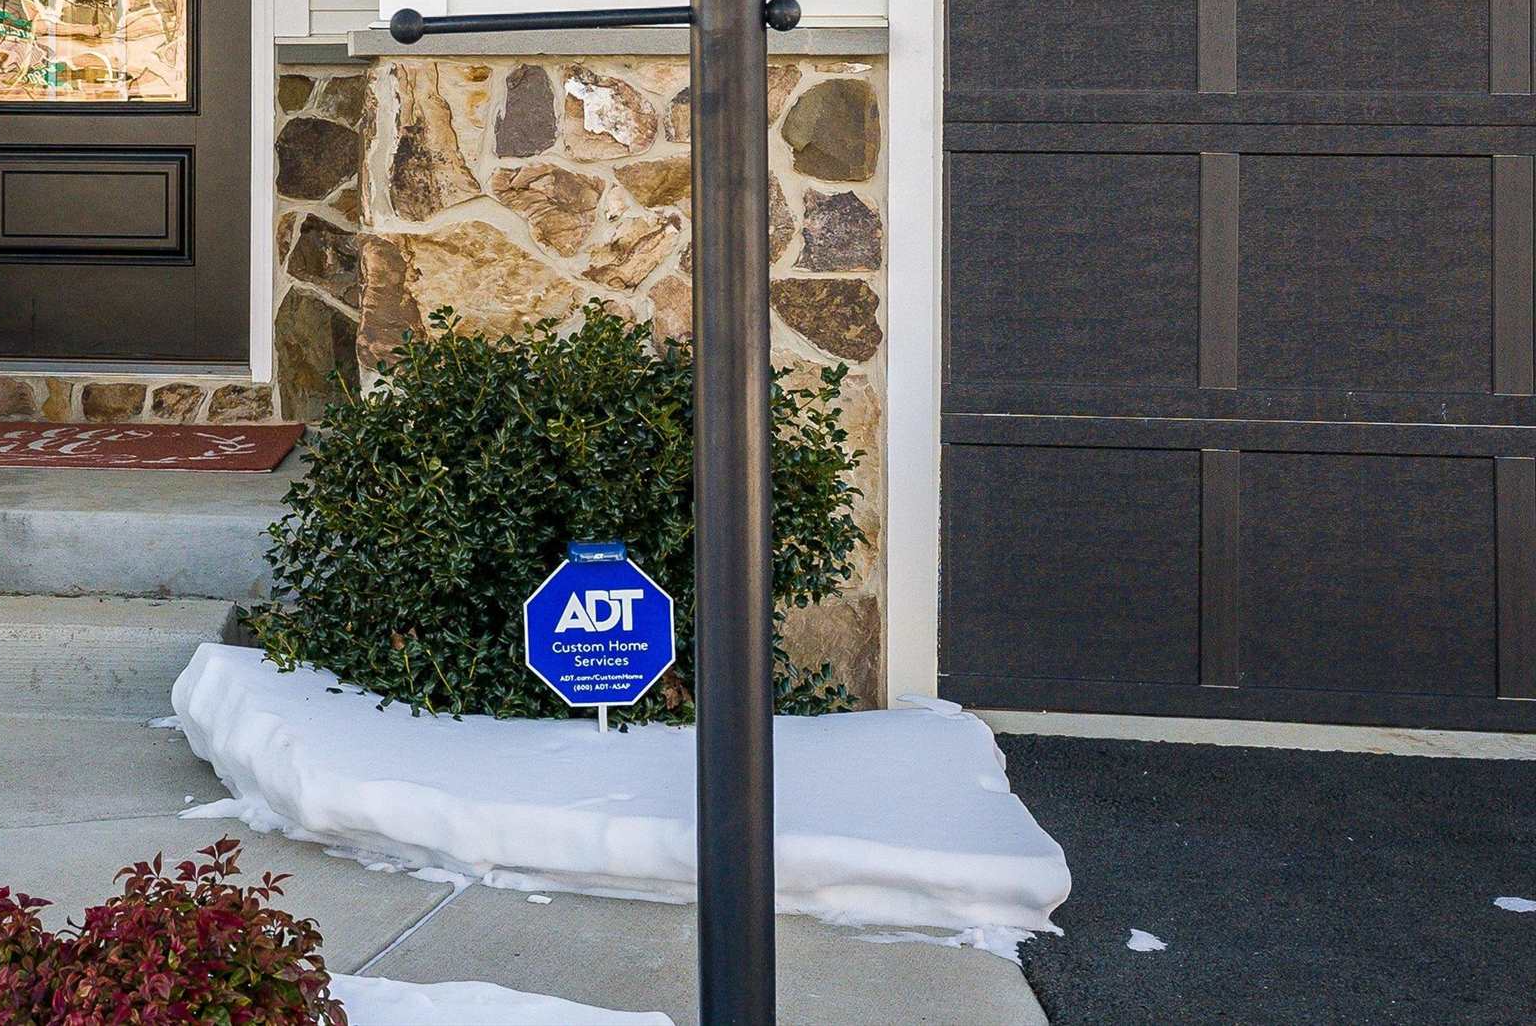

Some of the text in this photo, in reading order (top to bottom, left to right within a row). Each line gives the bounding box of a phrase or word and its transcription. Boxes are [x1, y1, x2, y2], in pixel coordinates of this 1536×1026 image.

[554, 589, 644, 633] ADT
[552, 641, 649, 653] Custom Home
[574, 655, 630, 667] Services
